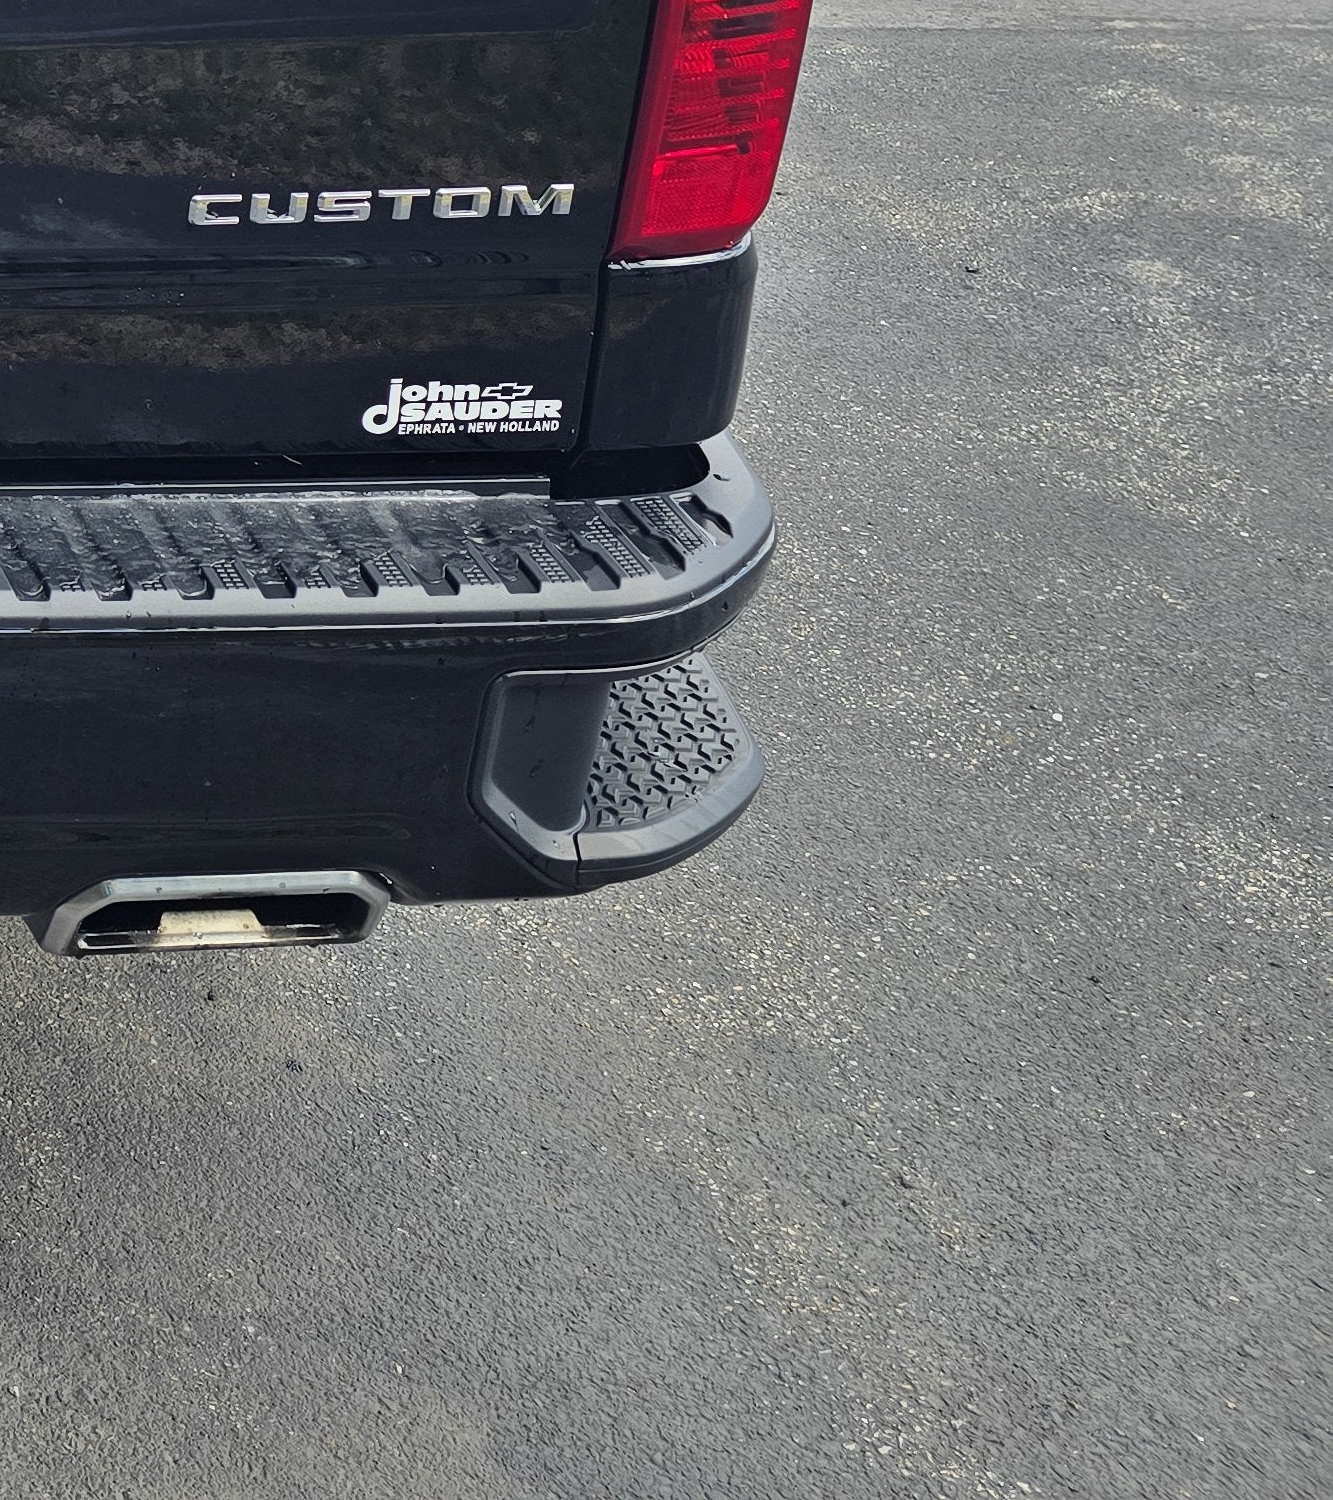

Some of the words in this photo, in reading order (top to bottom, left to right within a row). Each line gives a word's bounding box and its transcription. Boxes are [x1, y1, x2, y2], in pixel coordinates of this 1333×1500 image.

[187, 183, 575, 226] CUSTOM
[399, 399, 563, 423] SAUDER
[397, 422, 456, 435] EPHRATA
[467, 421, 497, 434] NEW
[499, 419, 560, 433] HOLLAND
